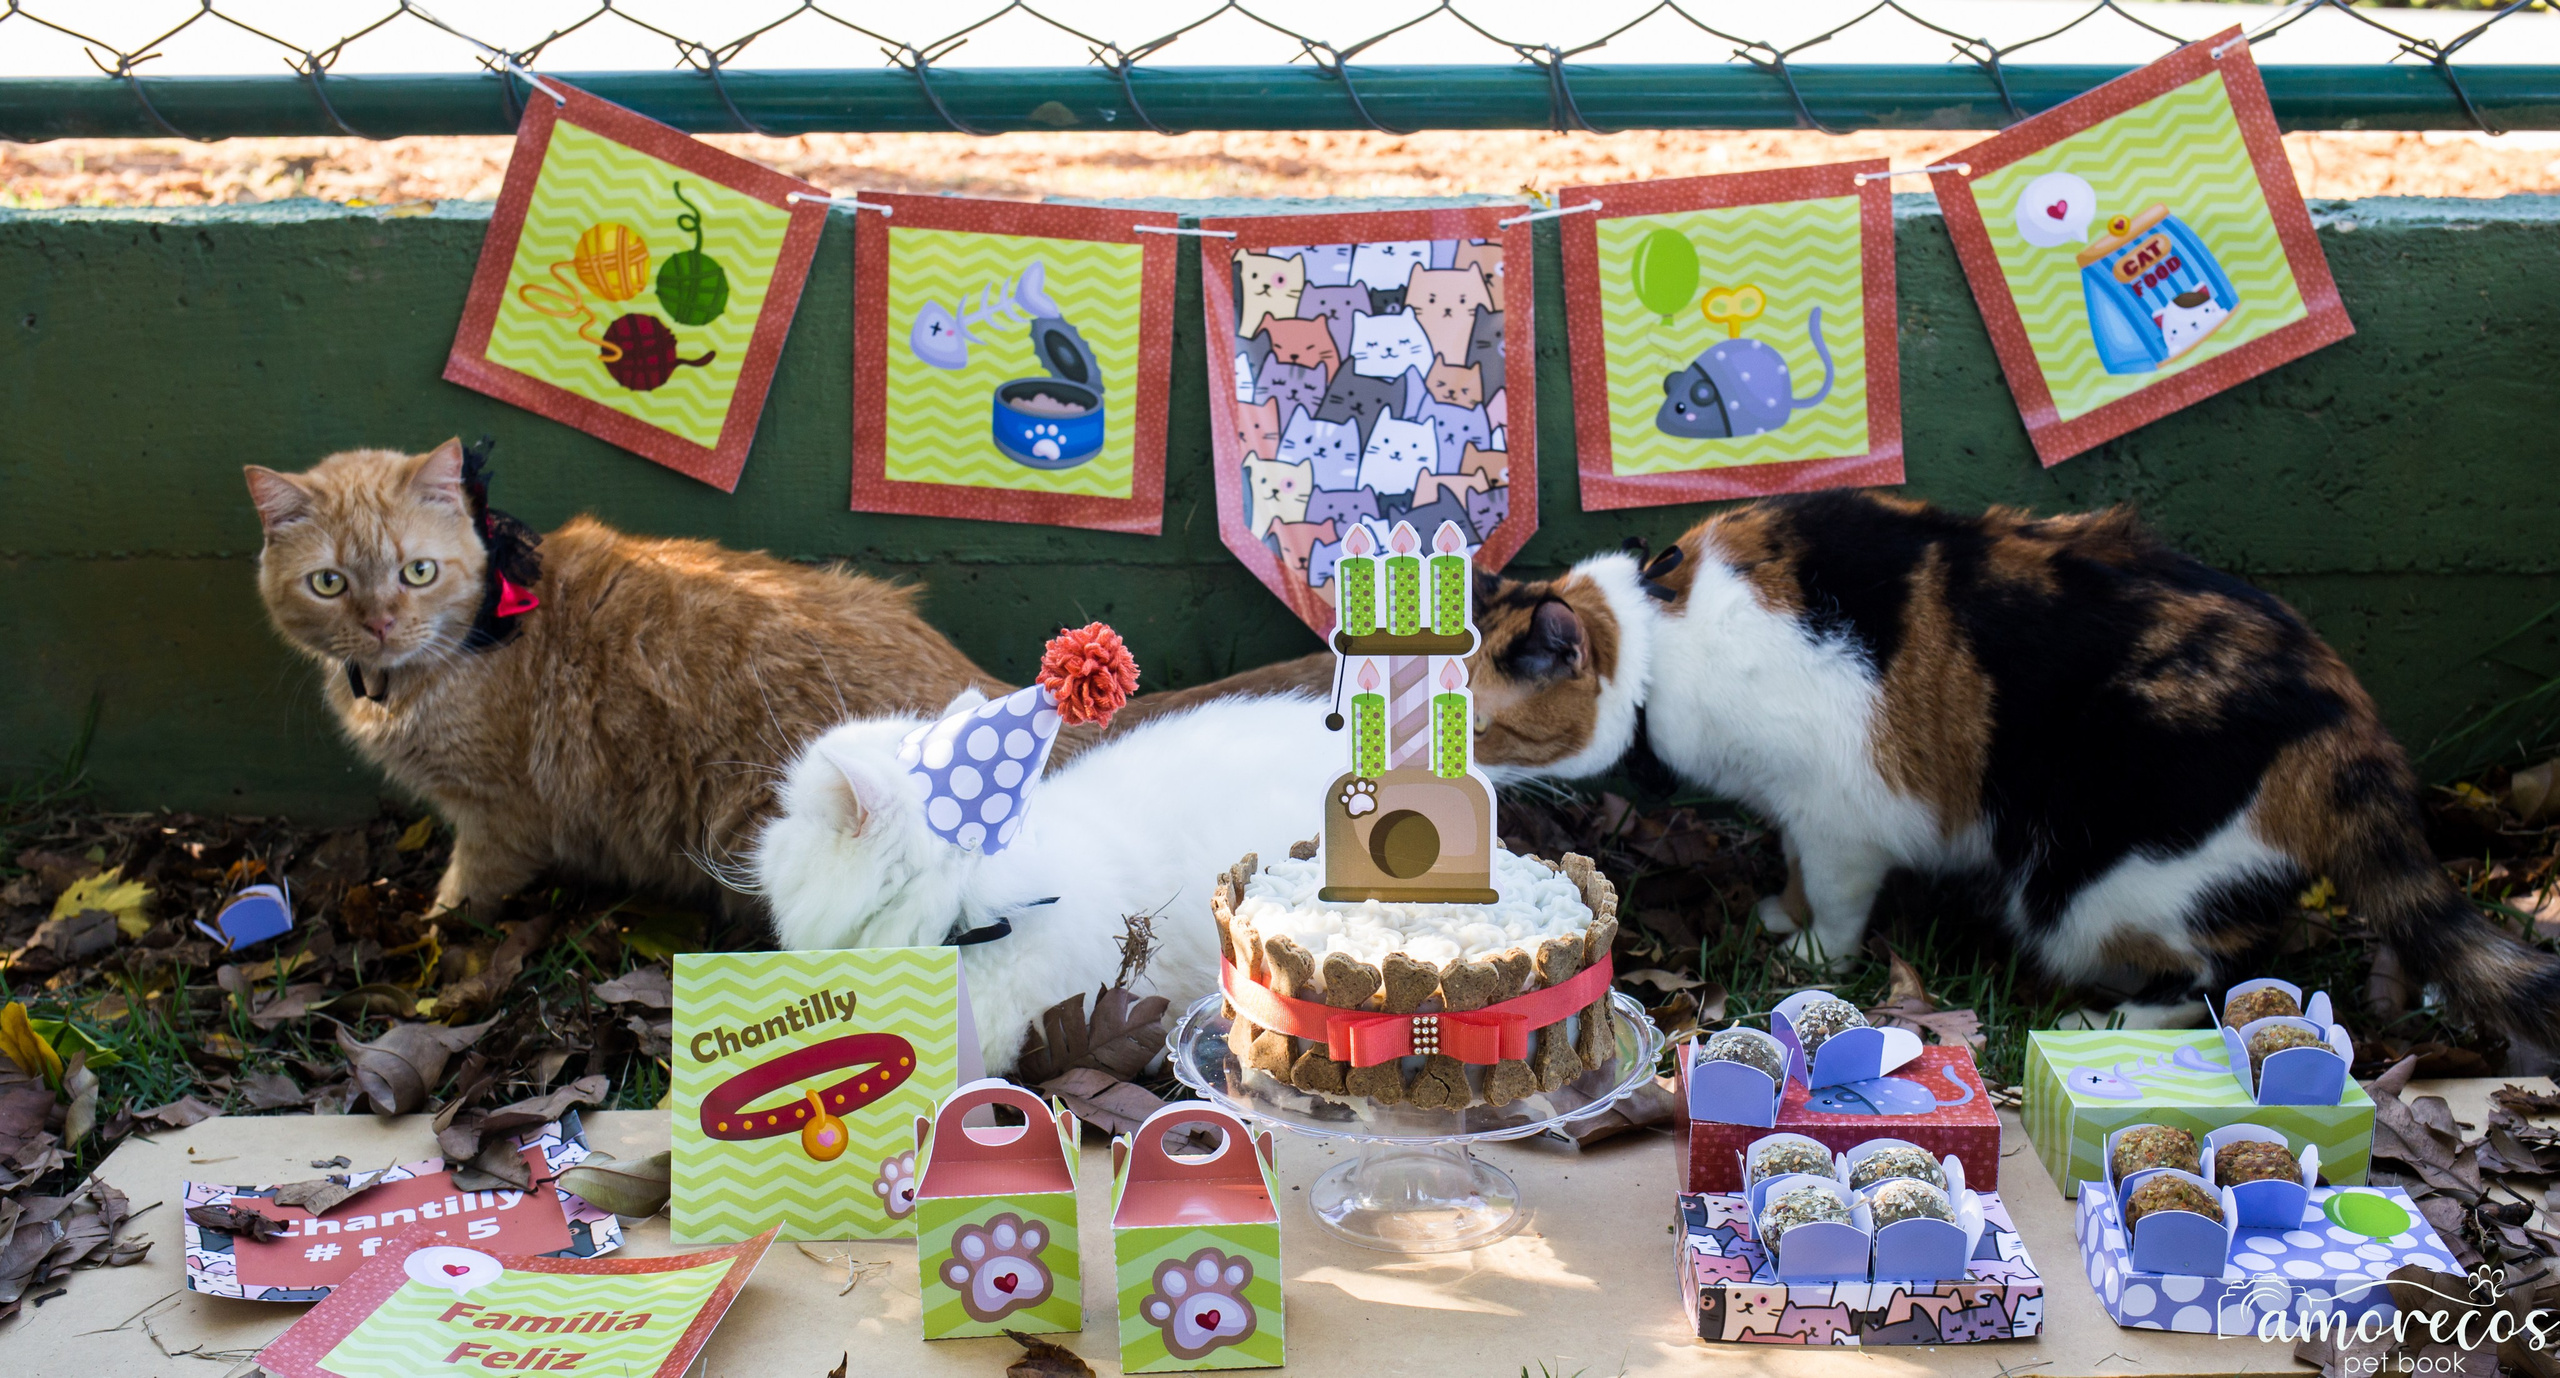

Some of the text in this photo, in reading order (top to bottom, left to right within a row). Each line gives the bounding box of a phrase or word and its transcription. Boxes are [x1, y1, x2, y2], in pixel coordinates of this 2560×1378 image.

[2122, 239, 2160, 277] CAT
[2131, 255, 2182, 298] FOOD
[690, 989, 857, 1063] Chantilly
[467, 1216, 501, 1240] 5
[437, 1301, 653, 1334] Família
[442, 1341, 588, 1371] Feliz
